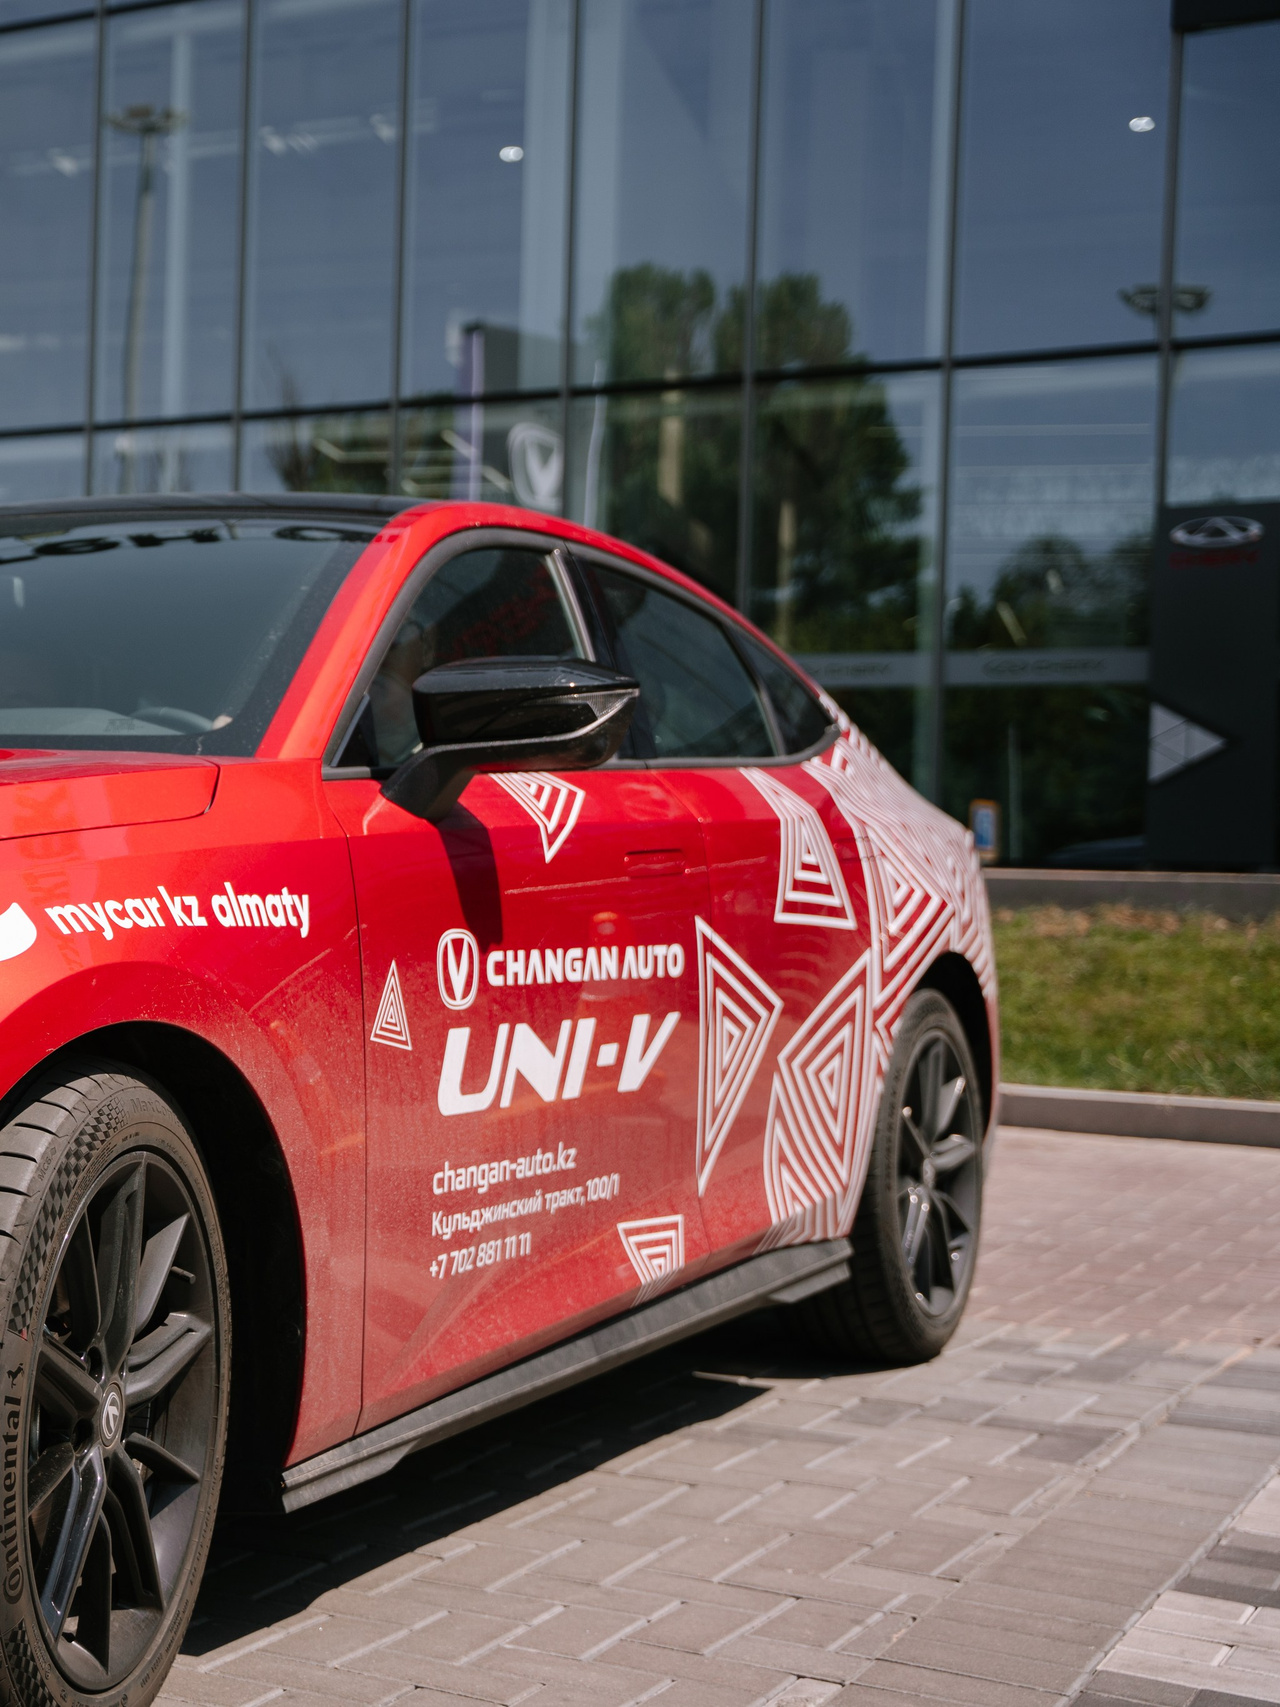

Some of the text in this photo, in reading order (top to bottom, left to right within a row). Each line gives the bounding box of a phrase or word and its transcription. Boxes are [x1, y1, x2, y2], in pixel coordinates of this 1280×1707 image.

[44, 881, 310, 941] mycar kz almaty
[486, 943, 685, 986] CHANGAN AUTO
[437, 1011, 681, 1116] UNI-V
[432, 1141, 578, 1195] changan-auto.kz
[431, 1188, 543, 1240] Кульджинский
[586, 1172, 620, 1202] 100/1
[429, 1231, 532, 1280] +7 702 881 11 11
[0, 1394, 24, 1606] Continental
